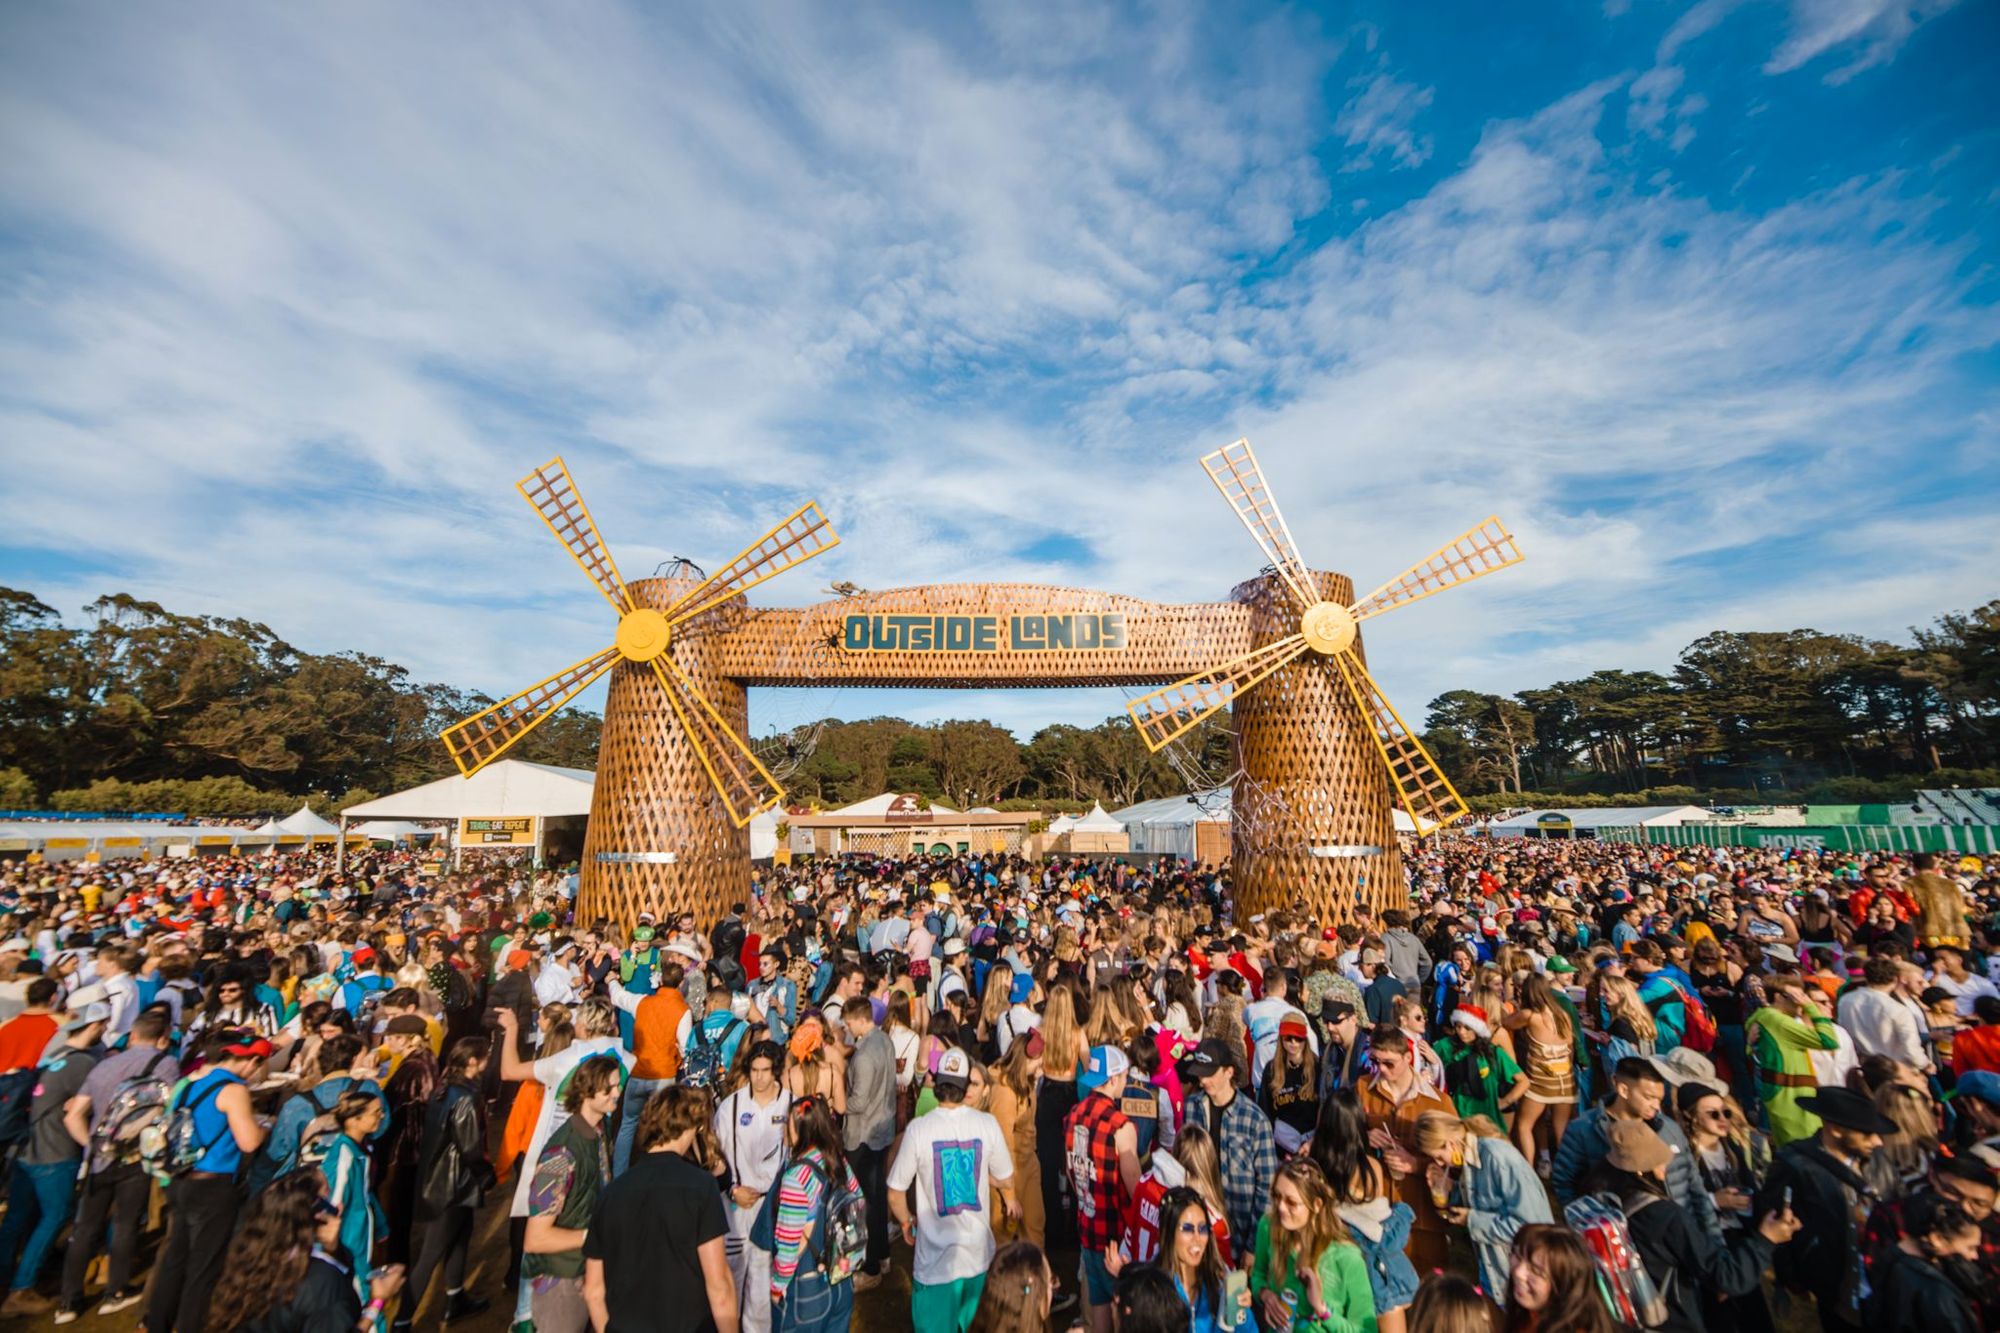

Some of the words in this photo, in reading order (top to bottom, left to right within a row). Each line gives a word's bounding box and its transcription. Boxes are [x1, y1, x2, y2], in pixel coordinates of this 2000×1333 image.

[845, 615, 997, 650] OUTSIDE
[1010, 614, 1124, 650] LANDS
[1758, 834, 1826, 850] HOUSE
